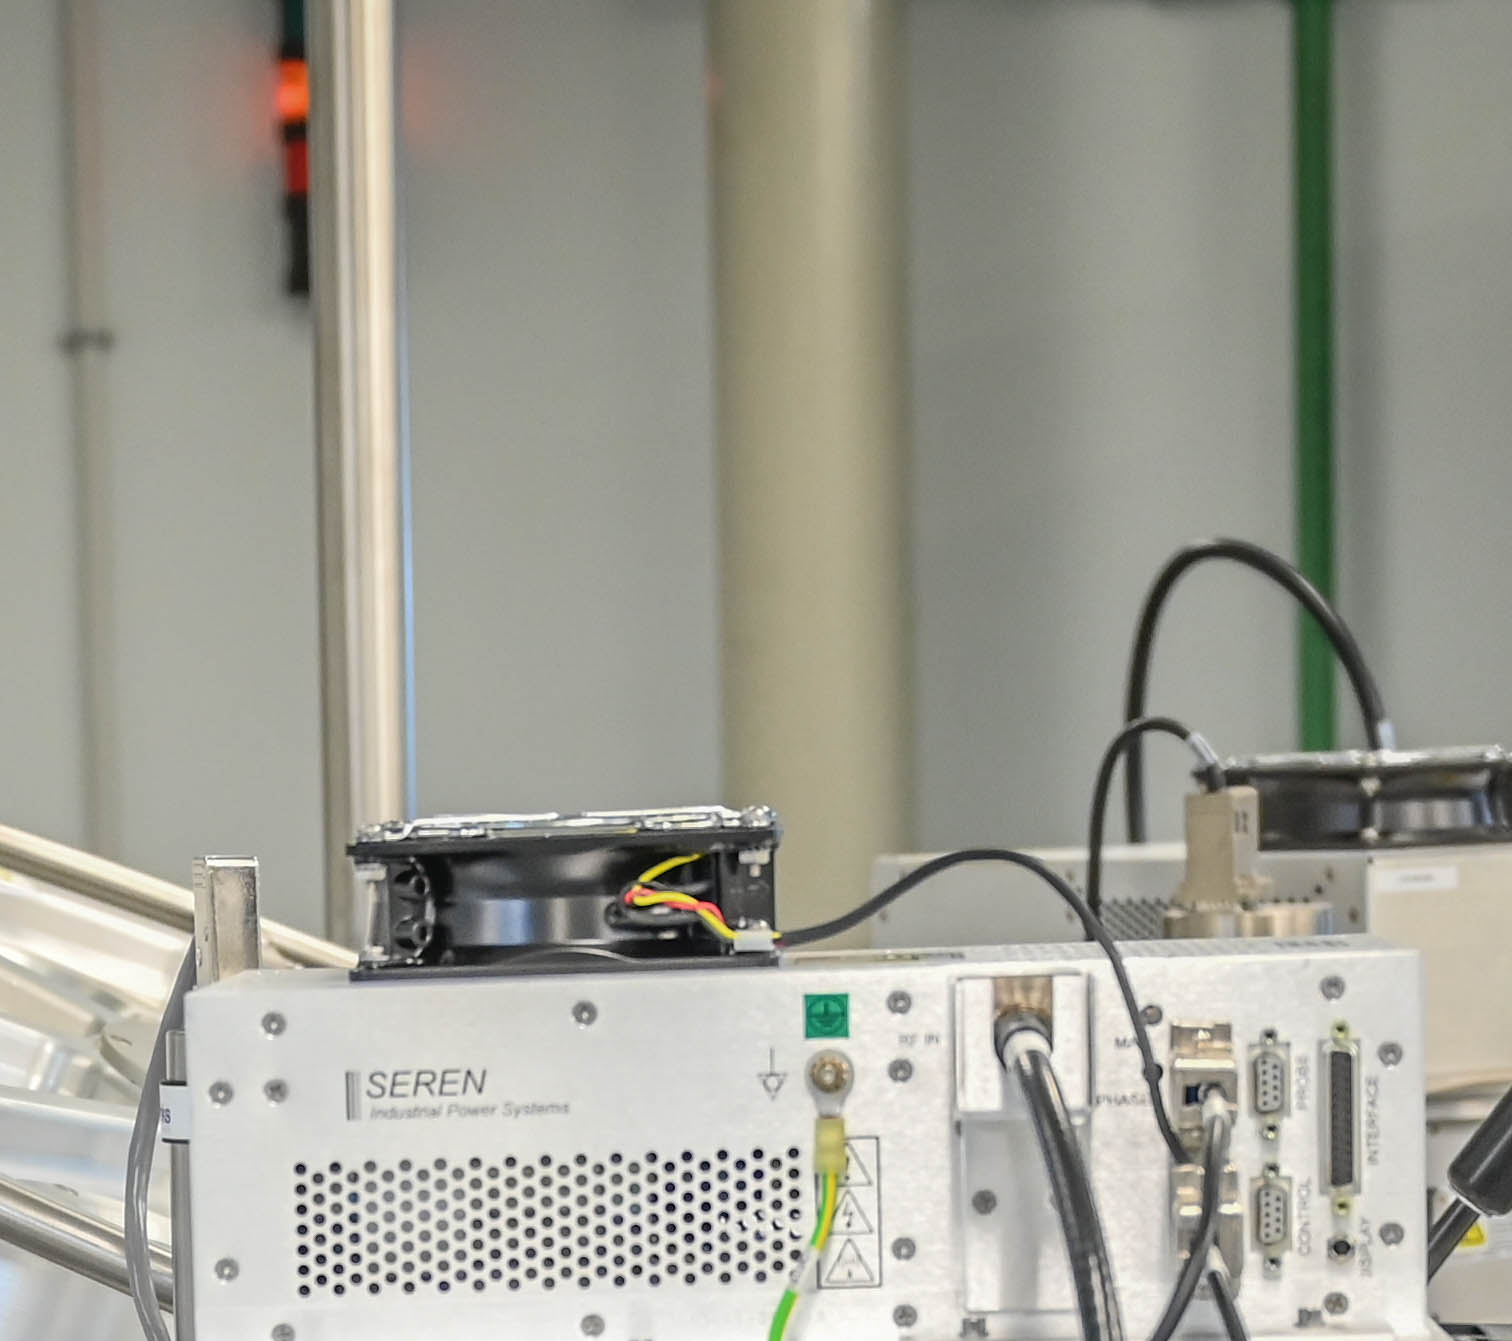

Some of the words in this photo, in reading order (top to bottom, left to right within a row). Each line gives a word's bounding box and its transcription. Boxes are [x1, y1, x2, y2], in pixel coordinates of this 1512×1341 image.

[923, 1032, 939, 1045] IN
[365, 1069, 487, 1099] SEREN
[370, 1103, 442, 1121] Industrial
[447, 1102, 497, 1118] Power
[502, 1101, 571, 1118] Systems
[1295, 1054, 1308, 1111] PROBE
[1366, 1076, 1380, 1165] INTERFACE
[1296, 1178, 1312, 1256] CONTROL
[1359, 1217, 1373, 1277] DISPLAY
